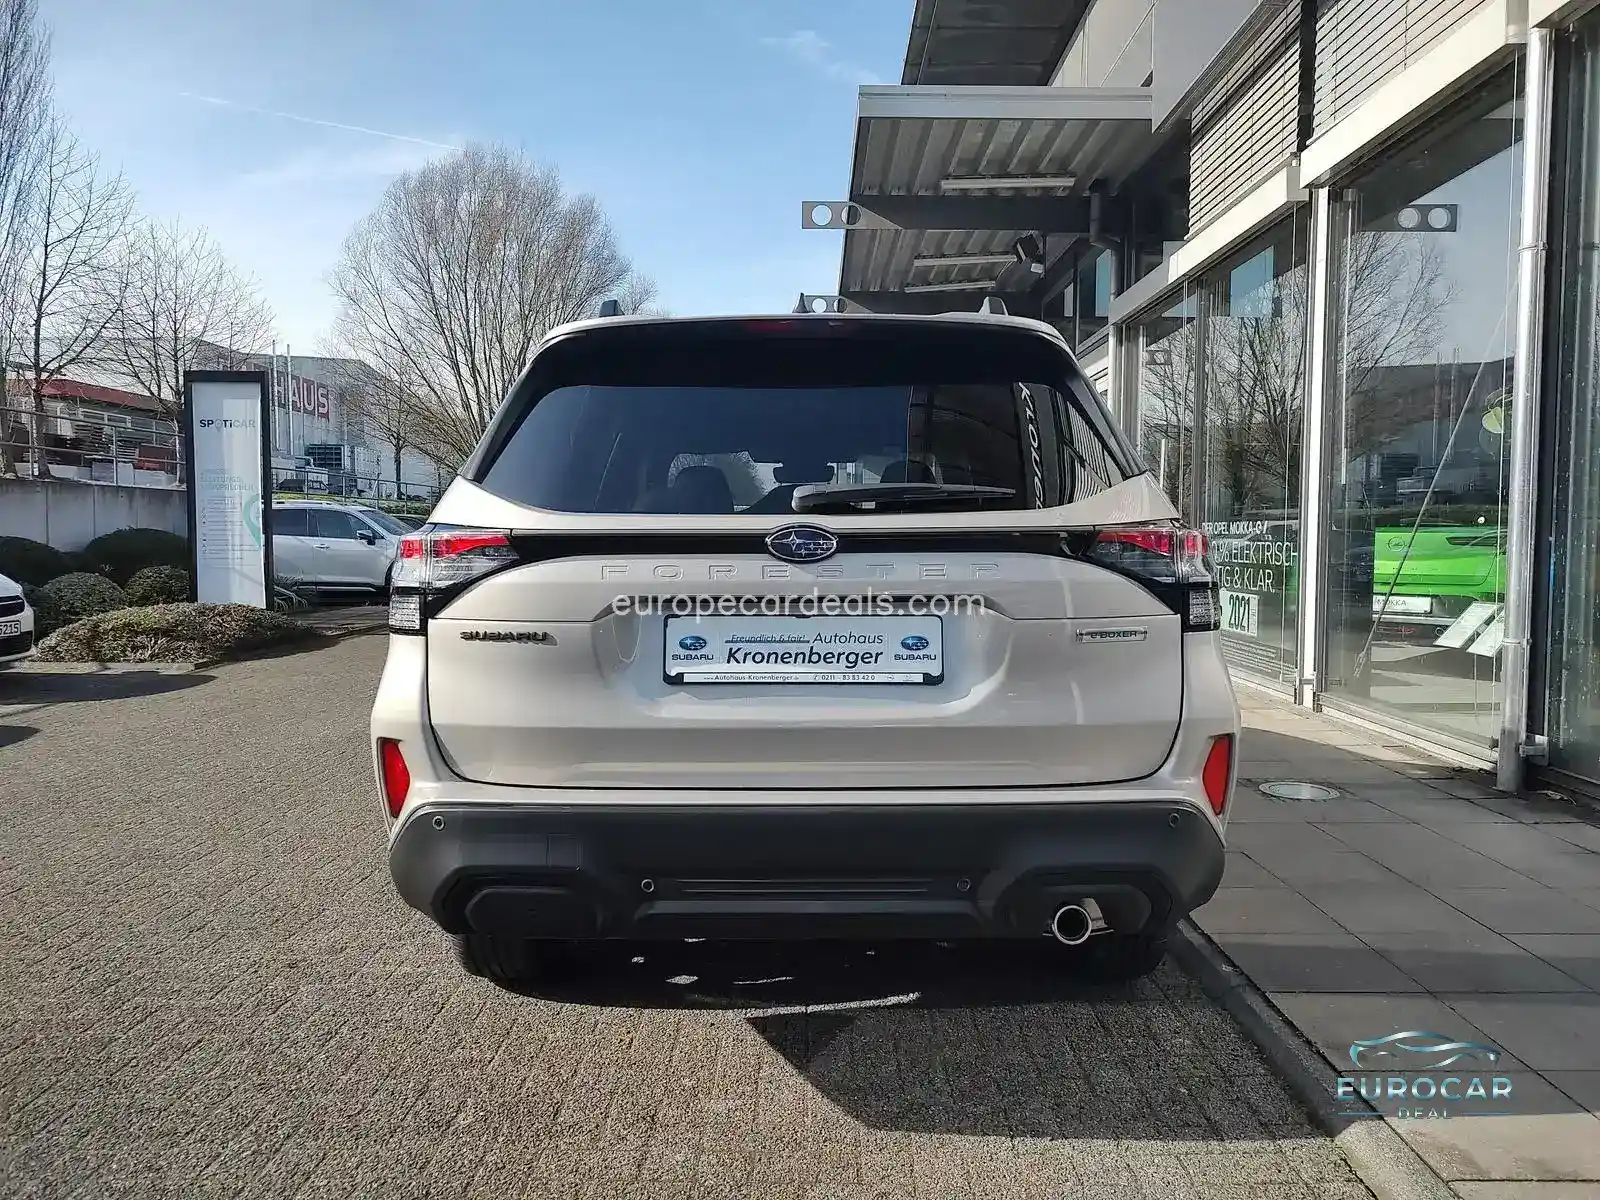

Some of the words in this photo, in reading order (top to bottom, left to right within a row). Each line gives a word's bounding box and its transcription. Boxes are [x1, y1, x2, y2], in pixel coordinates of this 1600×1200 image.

[1214, 521, 1229, 534] OPEL
[1232, 541, 1298, 567] ELEKTRISCH
[600, 563, 1001, 581] FORESTER
[1233, 566, 1242, 588] &
[1228, 593, 1251, 631] 2021
[459, 630, 549, 642] SUBARU
[730, 633, 777, 643] Freundlich
[812, 630, 884, 645] Autohaus
[671, 653, 714, 661] SUBARU
[726, 646, 884, 669] Kronenberger
[893, 653, 937, 661] SUBARU
